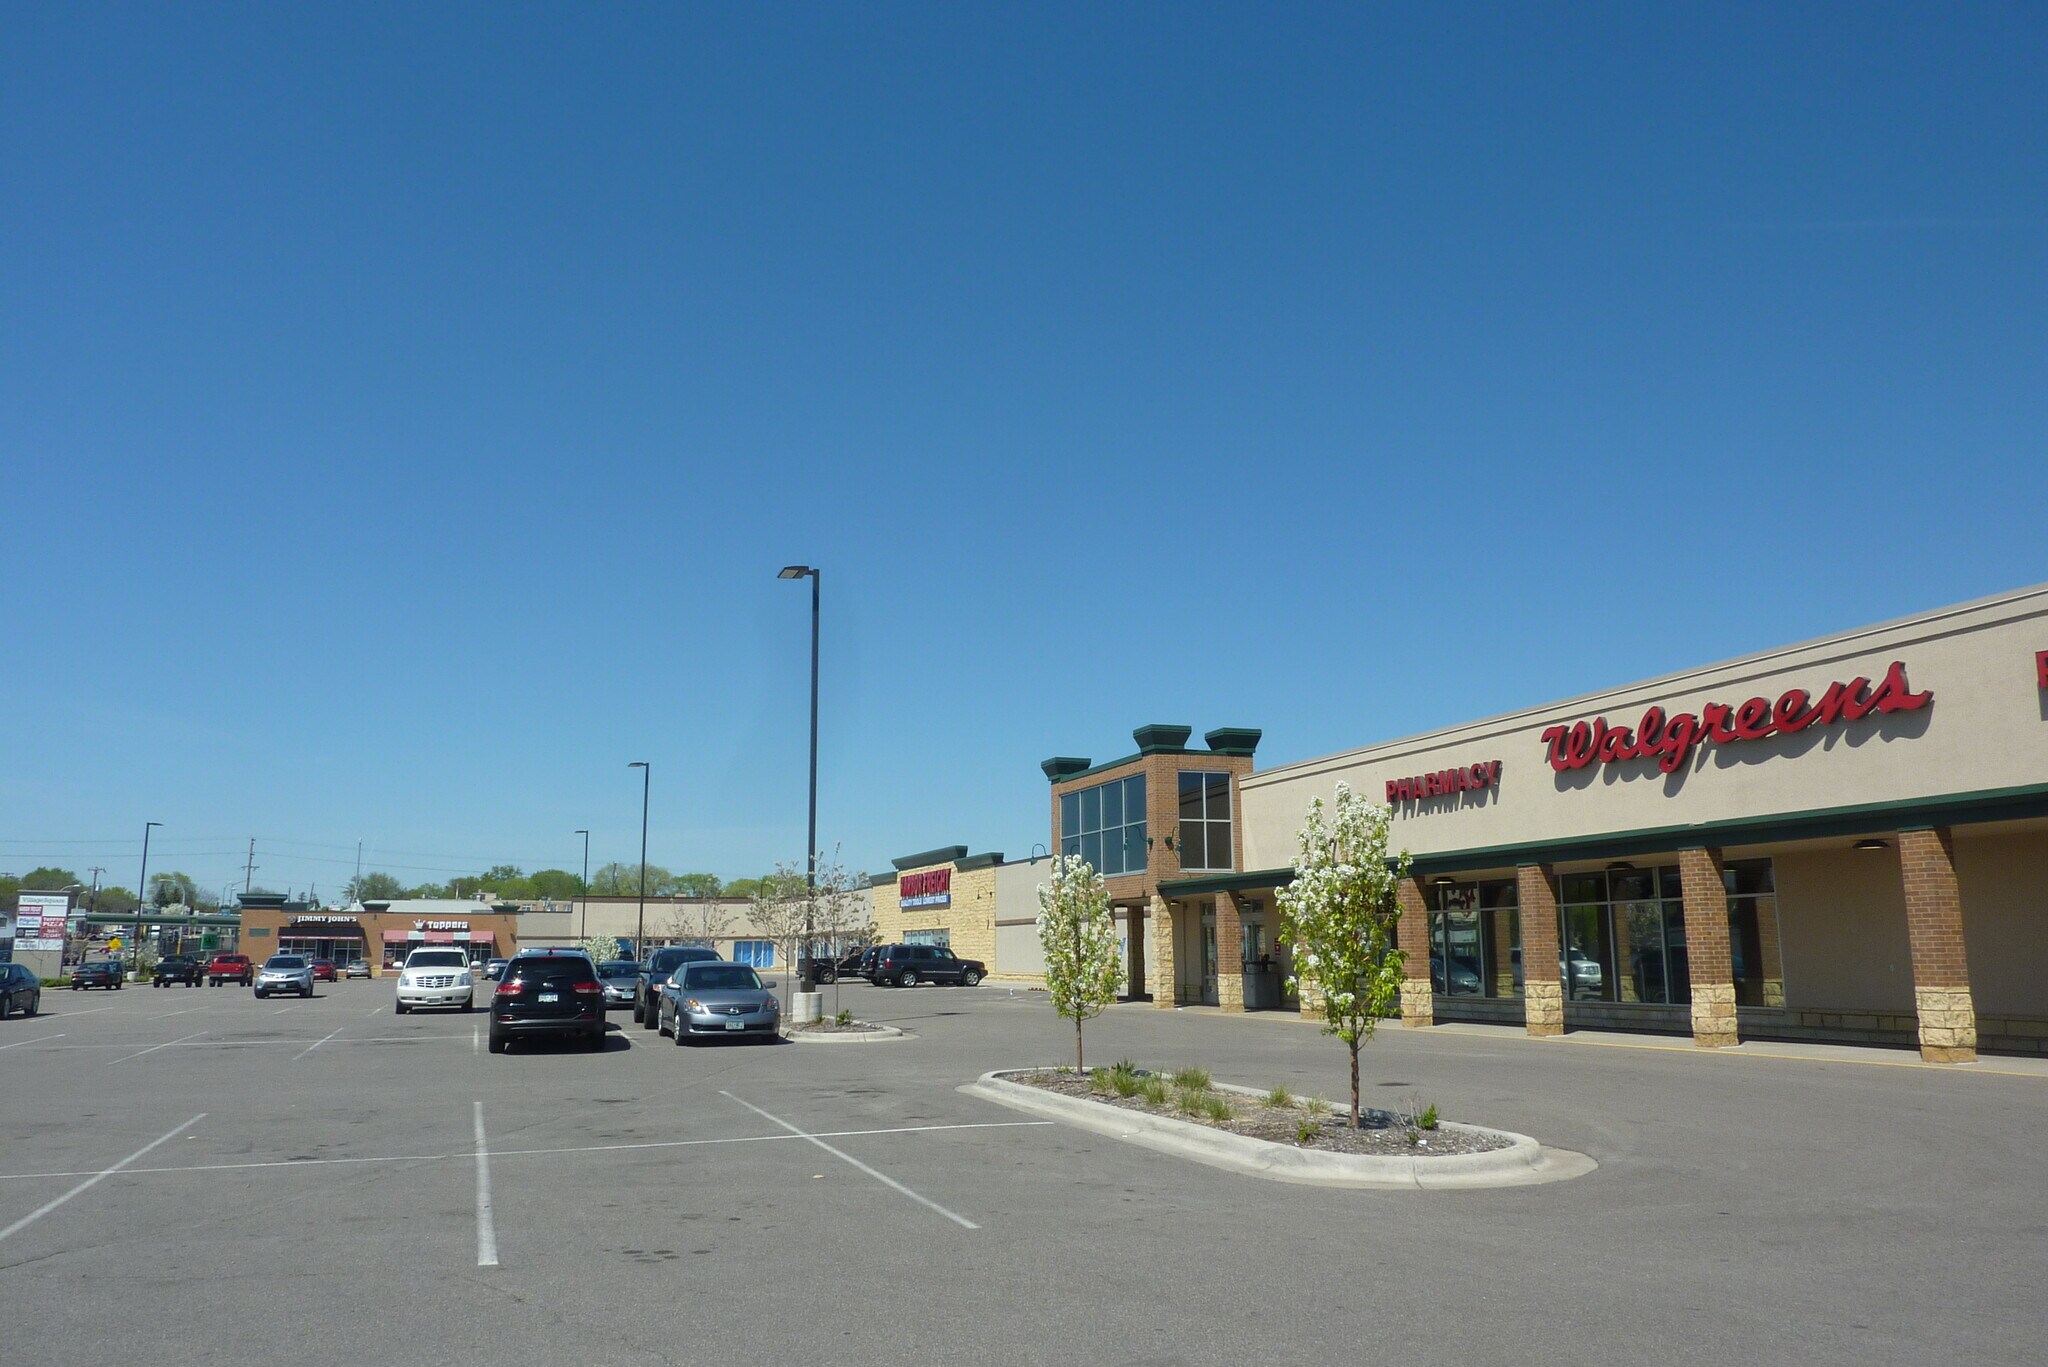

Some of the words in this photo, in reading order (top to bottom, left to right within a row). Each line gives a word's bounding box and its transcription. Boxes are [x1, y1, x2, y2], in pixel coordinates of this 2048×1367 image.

[1541, 660, 1933, 774] Walgreens
[1385, 760, 1503, 802] PHARMACY
[924, 869, 951, 893] FREIGHT
[296, 915, 327, 923] JIMMY
[327, 915, 357, 923] JOHN'S
